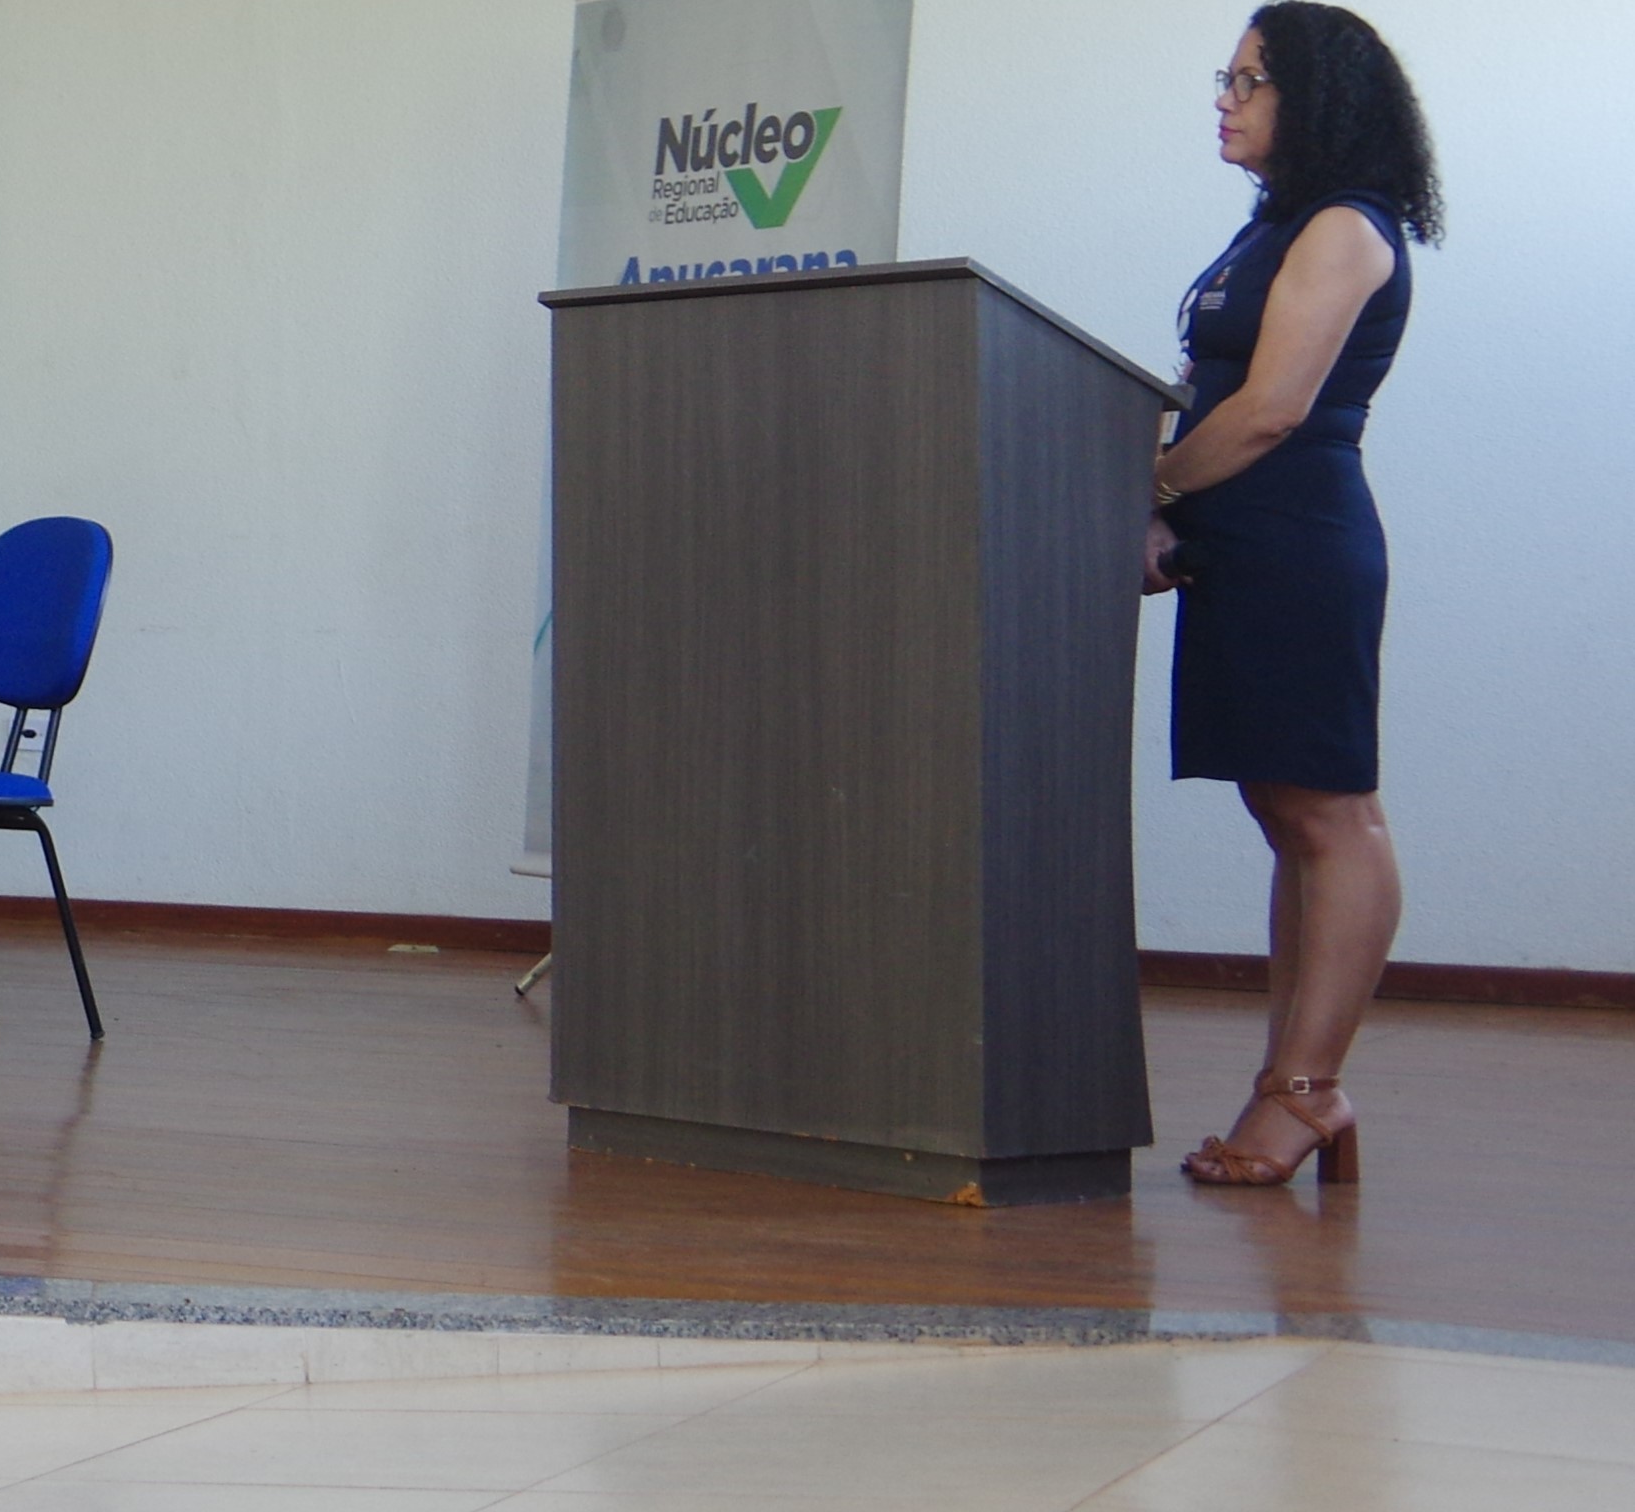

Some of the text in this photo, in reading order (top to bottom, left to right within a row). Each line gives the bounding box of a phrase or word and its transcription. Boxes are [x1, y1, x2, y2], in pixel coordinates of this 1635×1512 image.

[655, 102, 816, 176] Núcleo
[652, 170, 720, 202] Regional
[648, 197, 739, 225] de Educação
